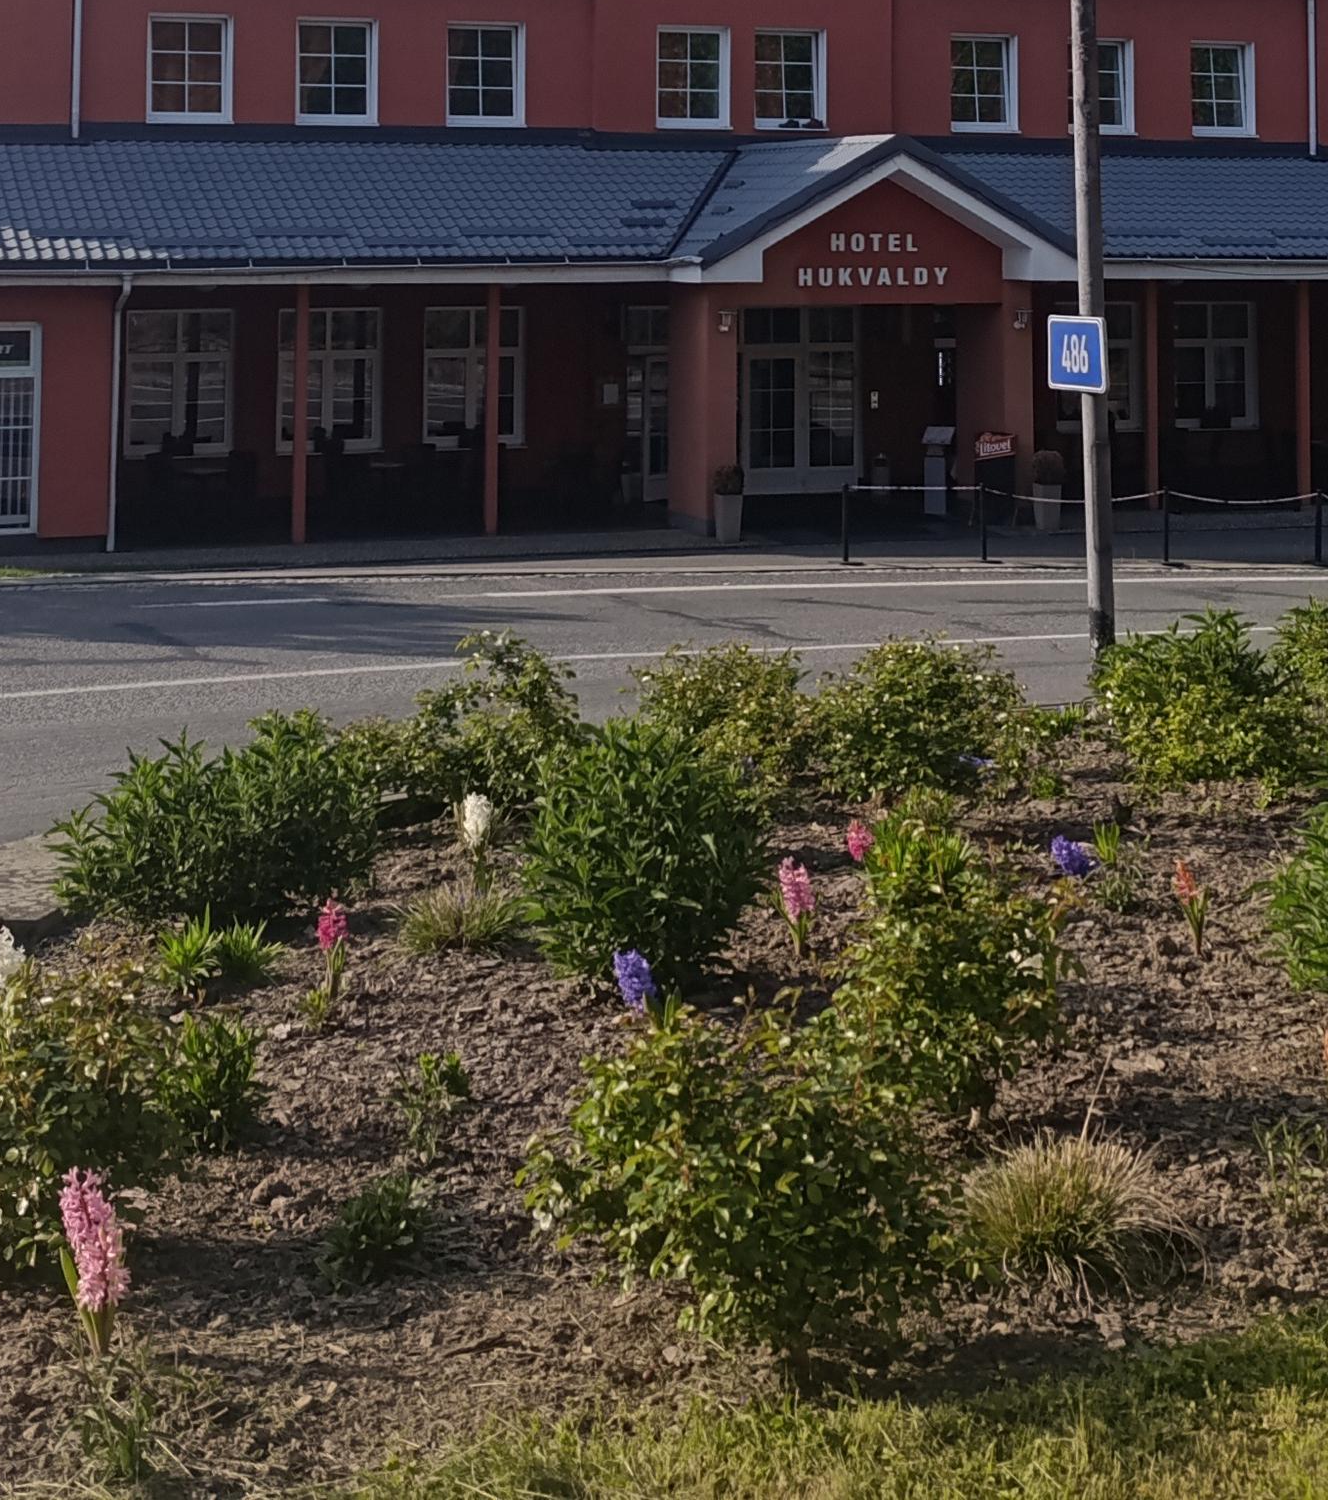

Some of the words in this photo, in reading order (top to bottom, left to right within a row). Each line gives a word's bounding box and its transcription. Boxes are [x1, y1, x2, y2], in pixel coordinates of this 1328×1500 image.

[830, 233, 918, 252] HOTEL
[798, 267, 949, 287] HUKVALDY
[1061, 333, 1089, 373] 486
